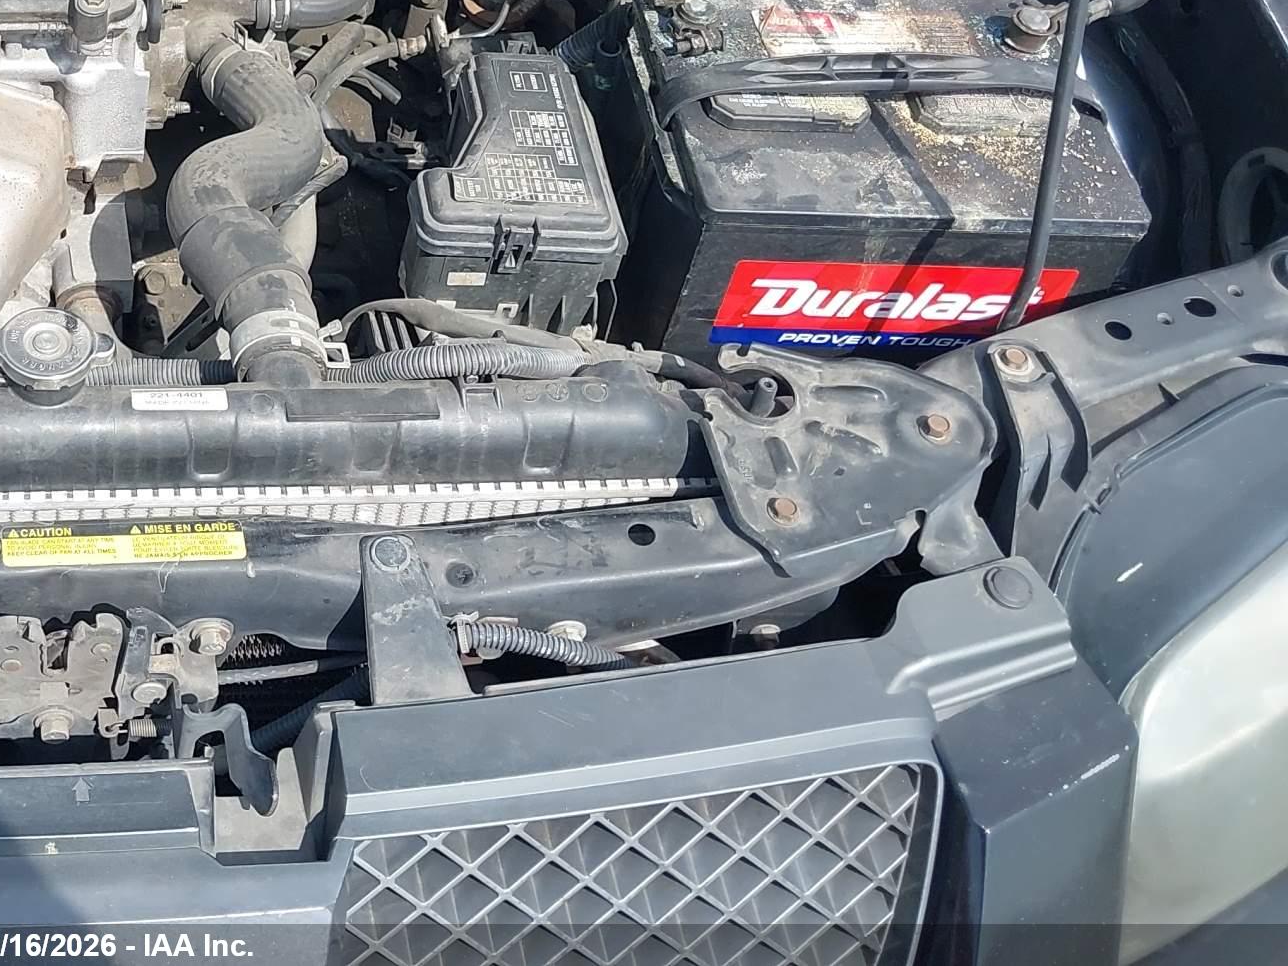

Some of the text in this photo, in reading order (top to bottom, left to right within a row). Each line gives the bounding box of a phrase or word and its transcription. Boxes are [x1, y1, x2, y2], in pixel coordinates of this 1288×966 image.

[778, 332, 970, 347] PROVEN TOUGH
[20, 527, 72, 537] CAUTION
[145, 523, 235, 533] MISE EN GARDE
